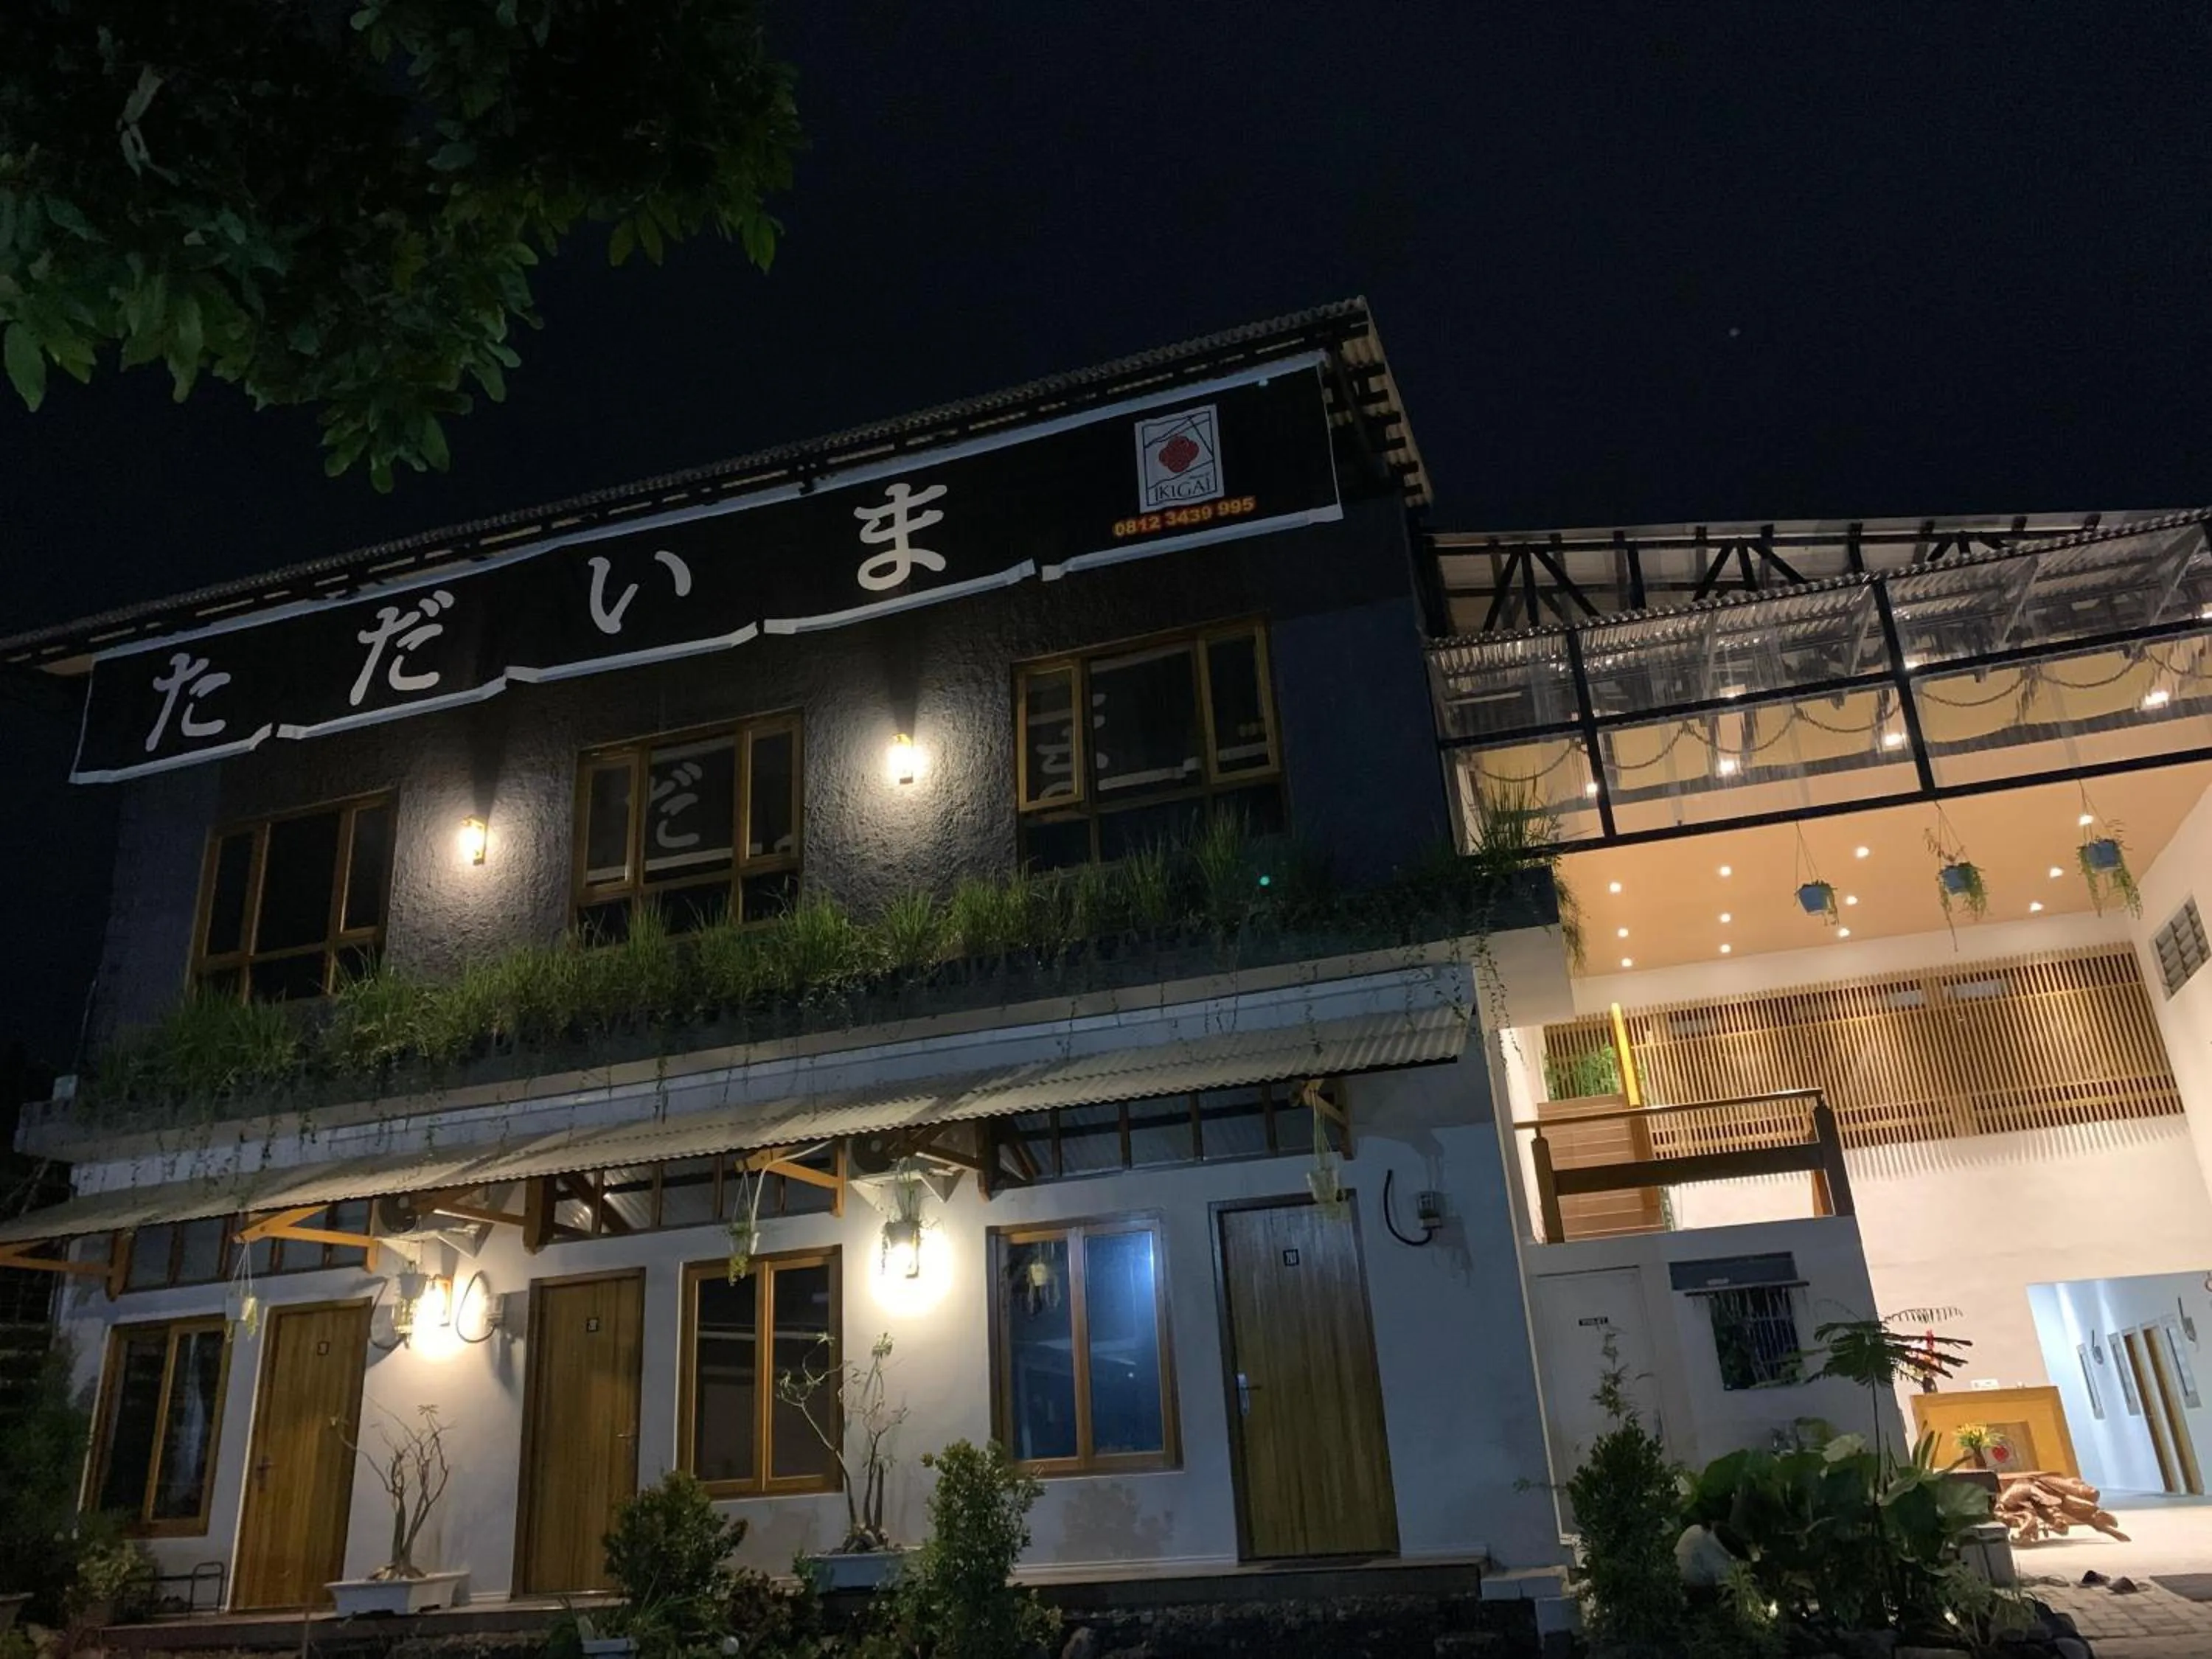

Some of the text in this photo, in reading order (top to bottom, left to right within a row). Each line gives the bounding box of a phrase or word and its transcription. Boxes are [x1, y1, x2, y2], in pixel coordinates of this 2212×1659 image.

[1154, 474, 1211, 502] IKIGAI
[1113, 516, 1161, 538] 0812
[1217, 495, 1256, 517] 995
[145, 483, 948, 752] ただいま
